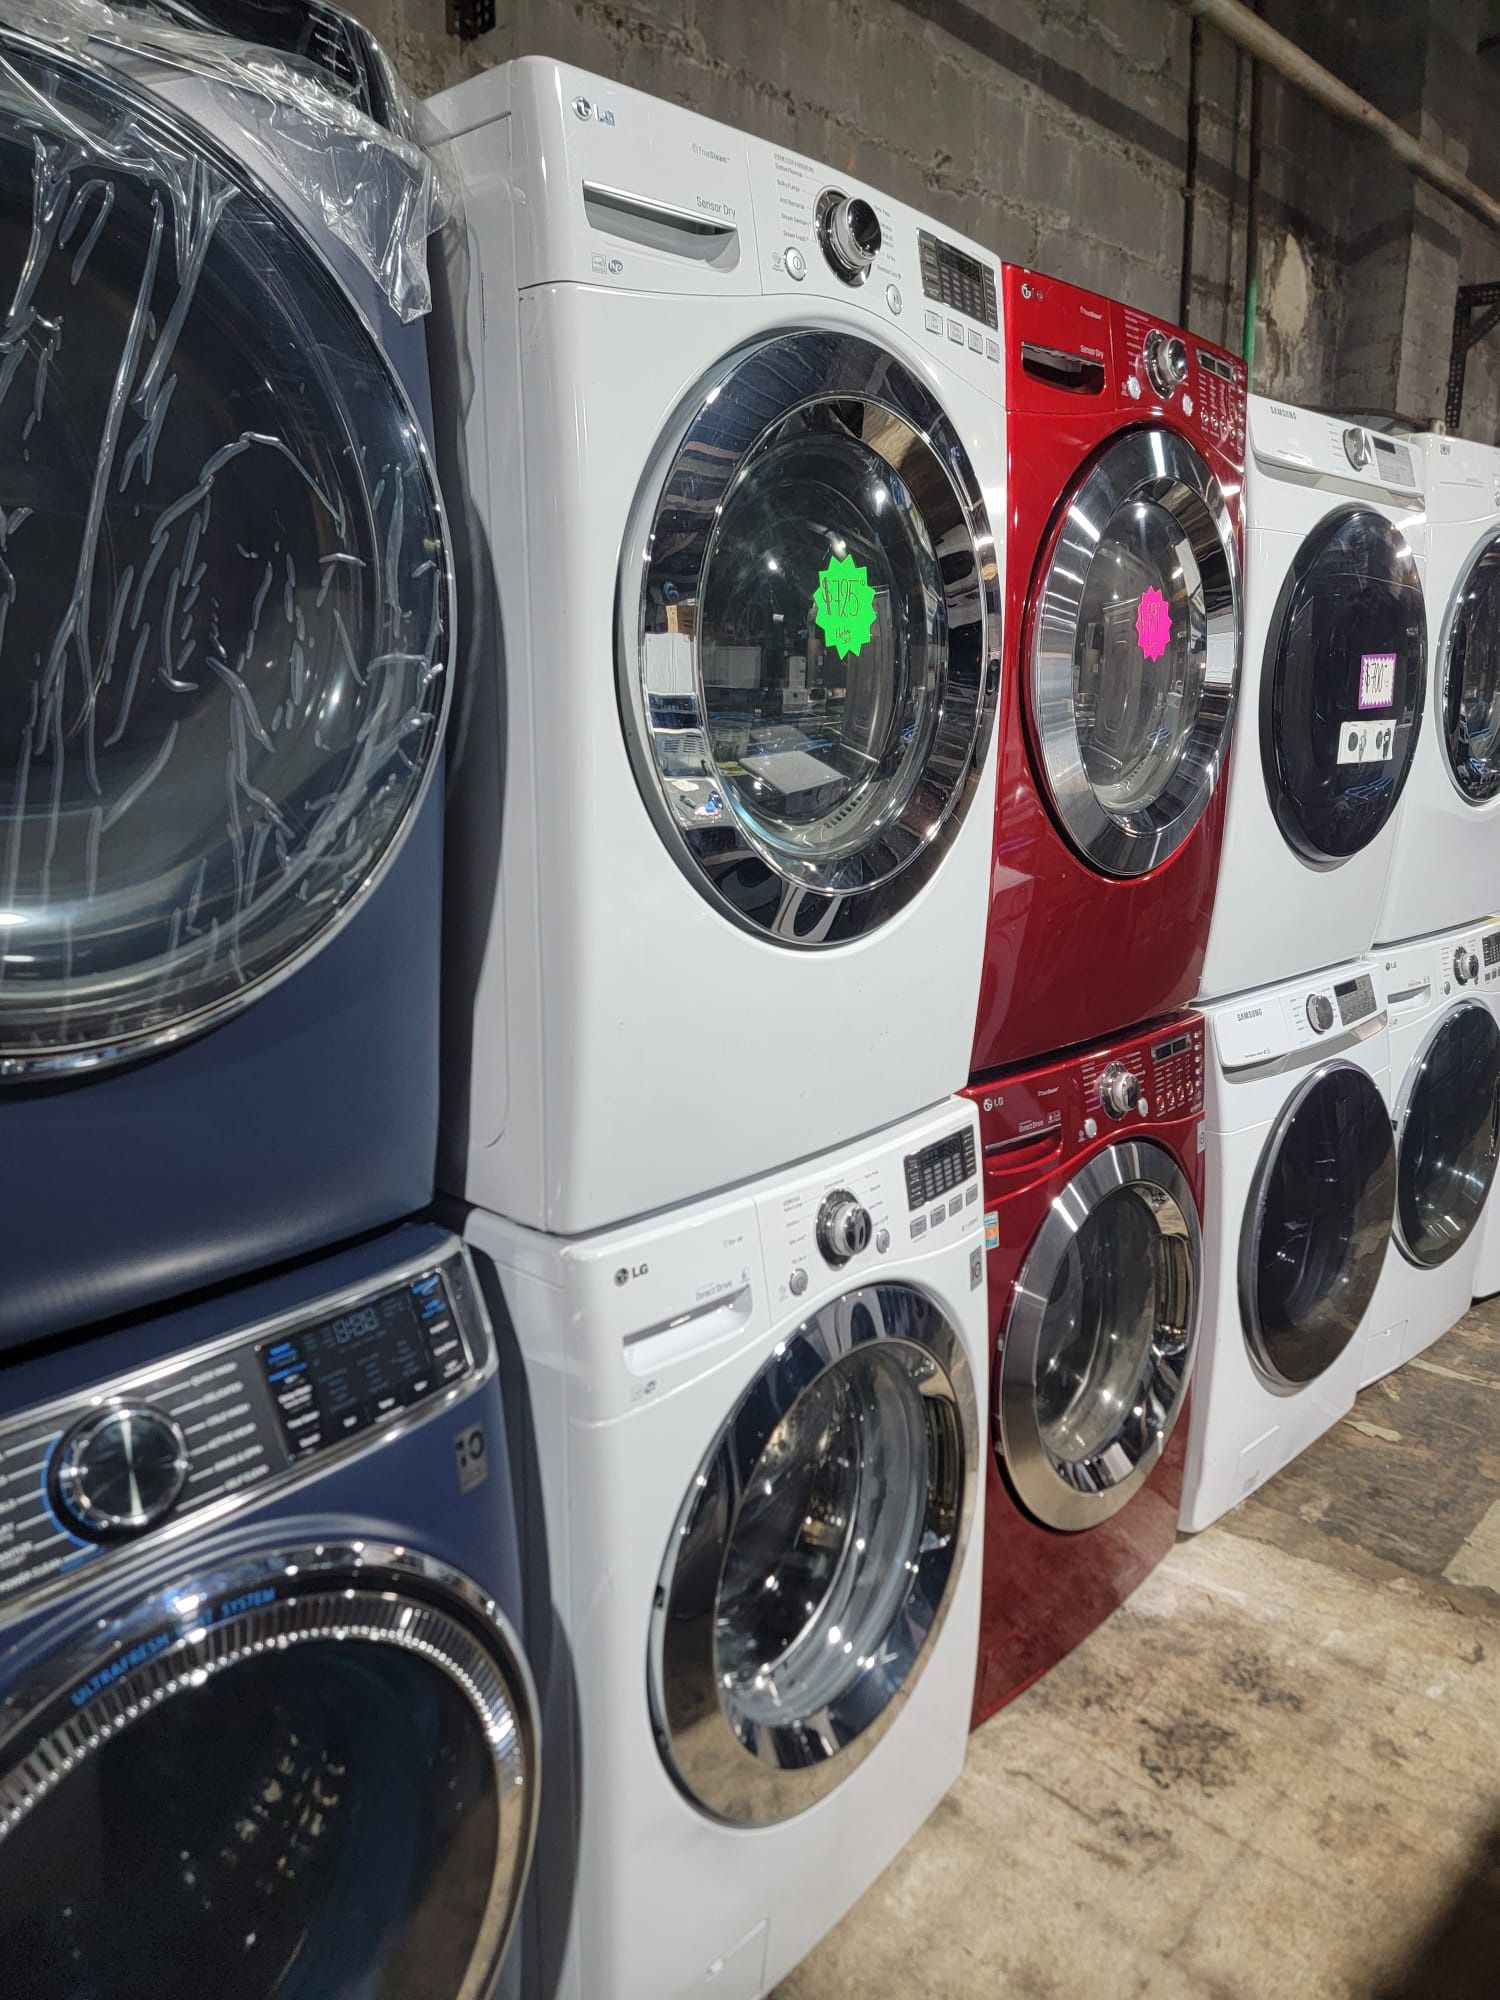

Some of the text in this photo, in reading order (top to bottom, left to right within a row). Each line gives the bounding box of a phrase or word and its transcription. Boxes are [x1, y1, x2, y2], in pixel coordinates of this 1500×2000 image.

[696, 195, 736, 219] Sensor Dry
[1270, 406, 1297, 420] SAMSUNG
[1237, 1008, 1263, 1022] SAMSUNG
[221, 1586, 276, 1618] SYSTEM
